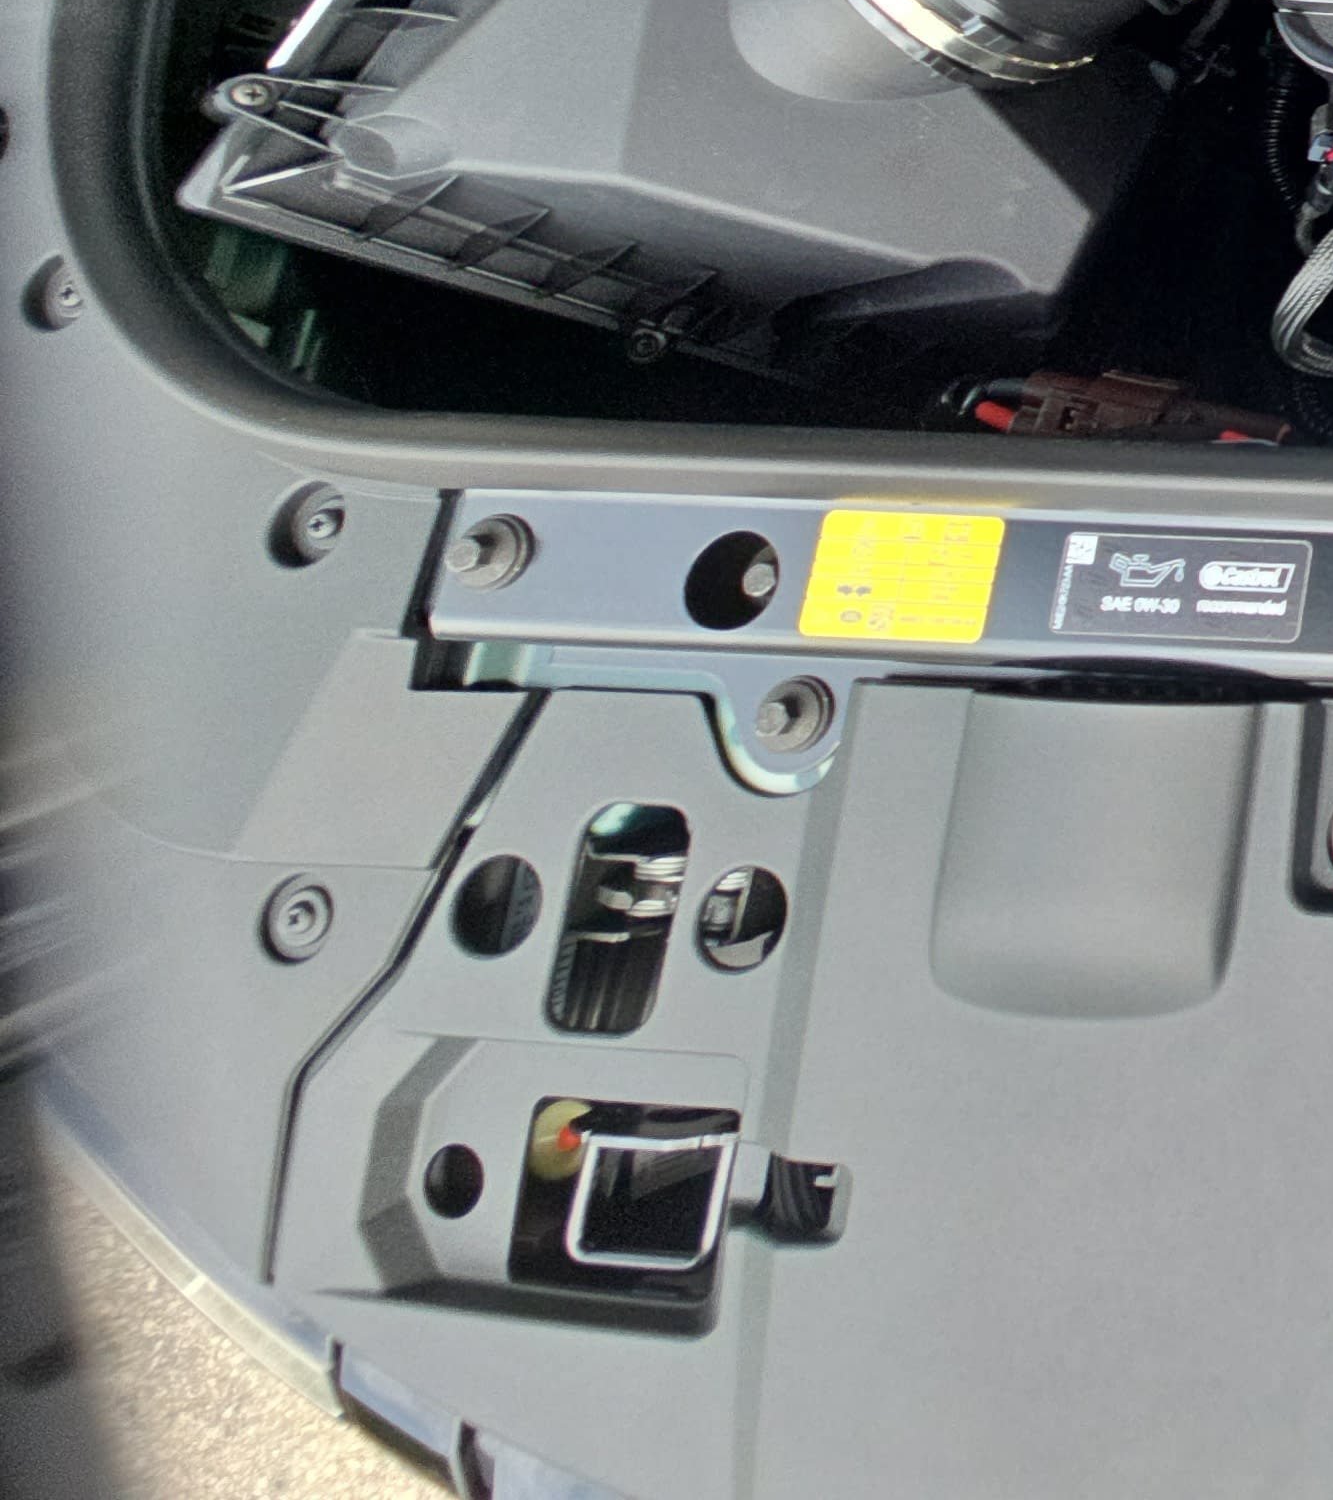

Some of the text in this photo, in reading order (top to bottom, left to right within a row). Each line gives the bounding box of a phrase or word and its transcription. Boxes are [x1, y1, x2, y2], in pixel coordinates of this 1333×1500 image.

[1222, 566, 1281, 588] Castrol
[1100, 595, 1181, 615] SAE 0W-30
